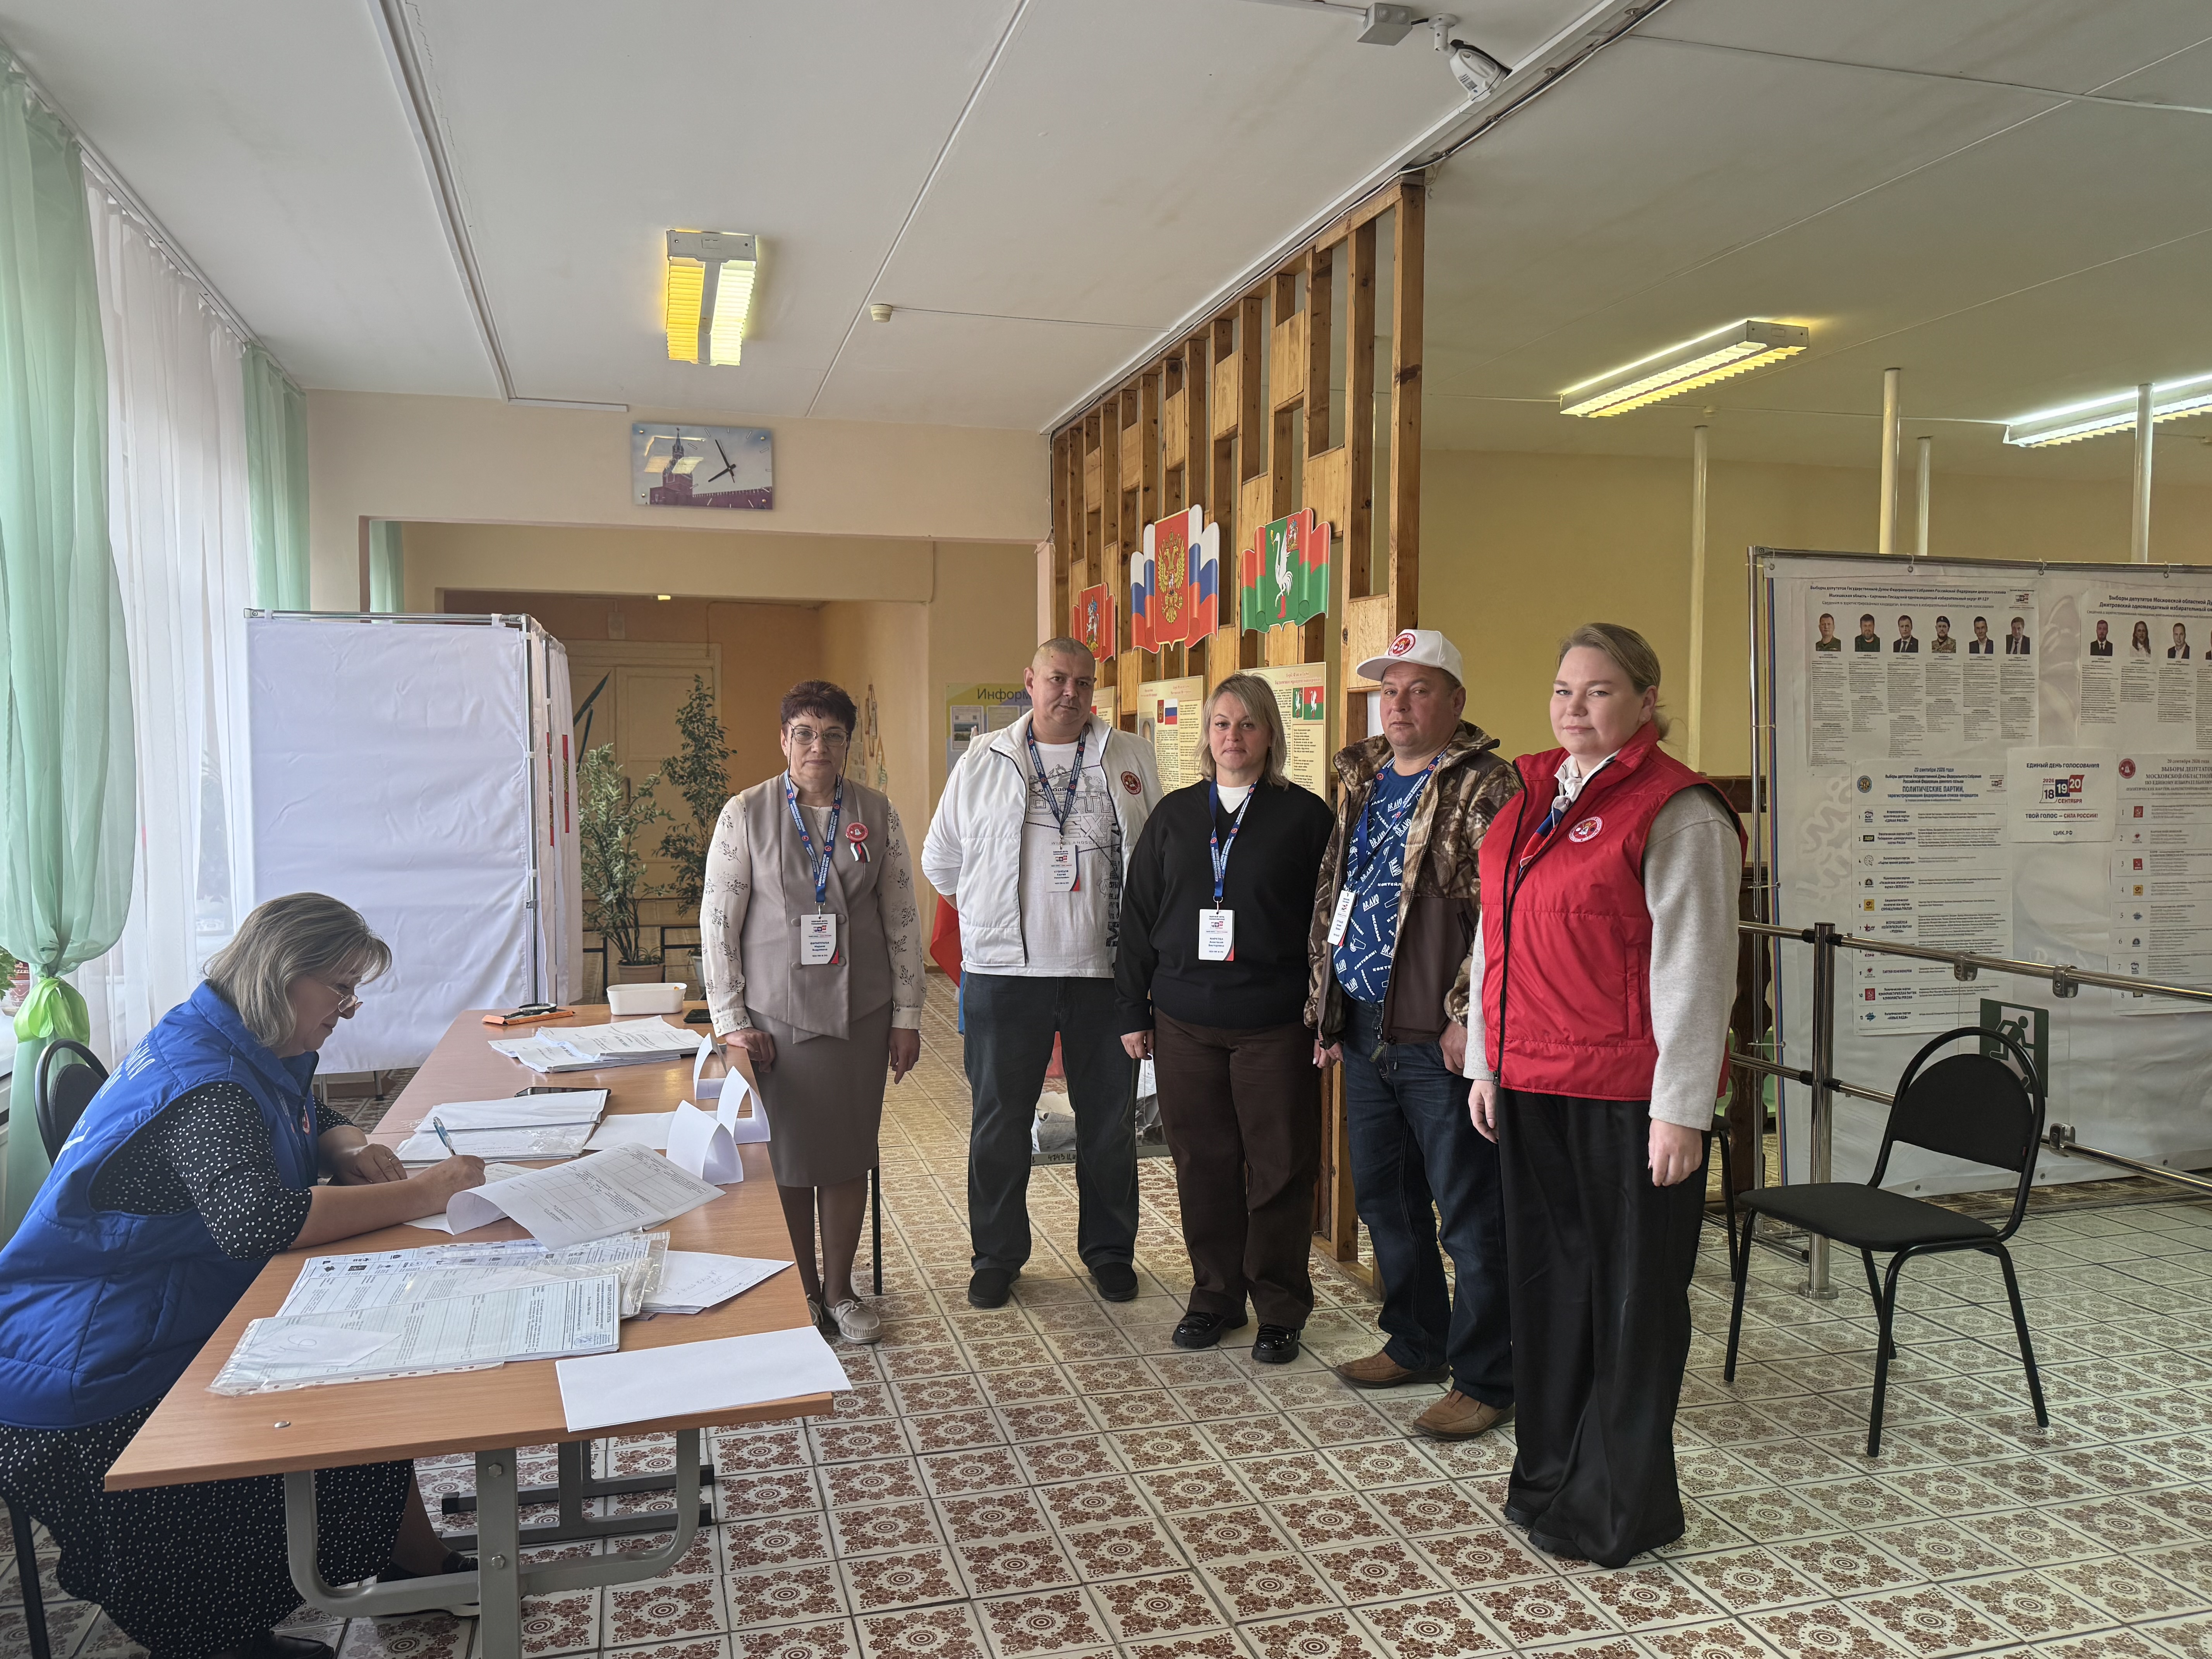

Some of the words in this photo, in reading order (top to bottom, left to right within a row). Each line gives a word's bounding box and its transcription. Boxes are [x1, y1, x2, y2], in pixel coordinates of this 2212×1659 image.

[2057, 783, 2067, 793] 19
[2069, 779, 2081, 788] 20
[2044, 790, 2054, 799] 18
[1390, 857, 1403, 876] BRAVO
[1362, 894, 1379, 910] BRAVO
